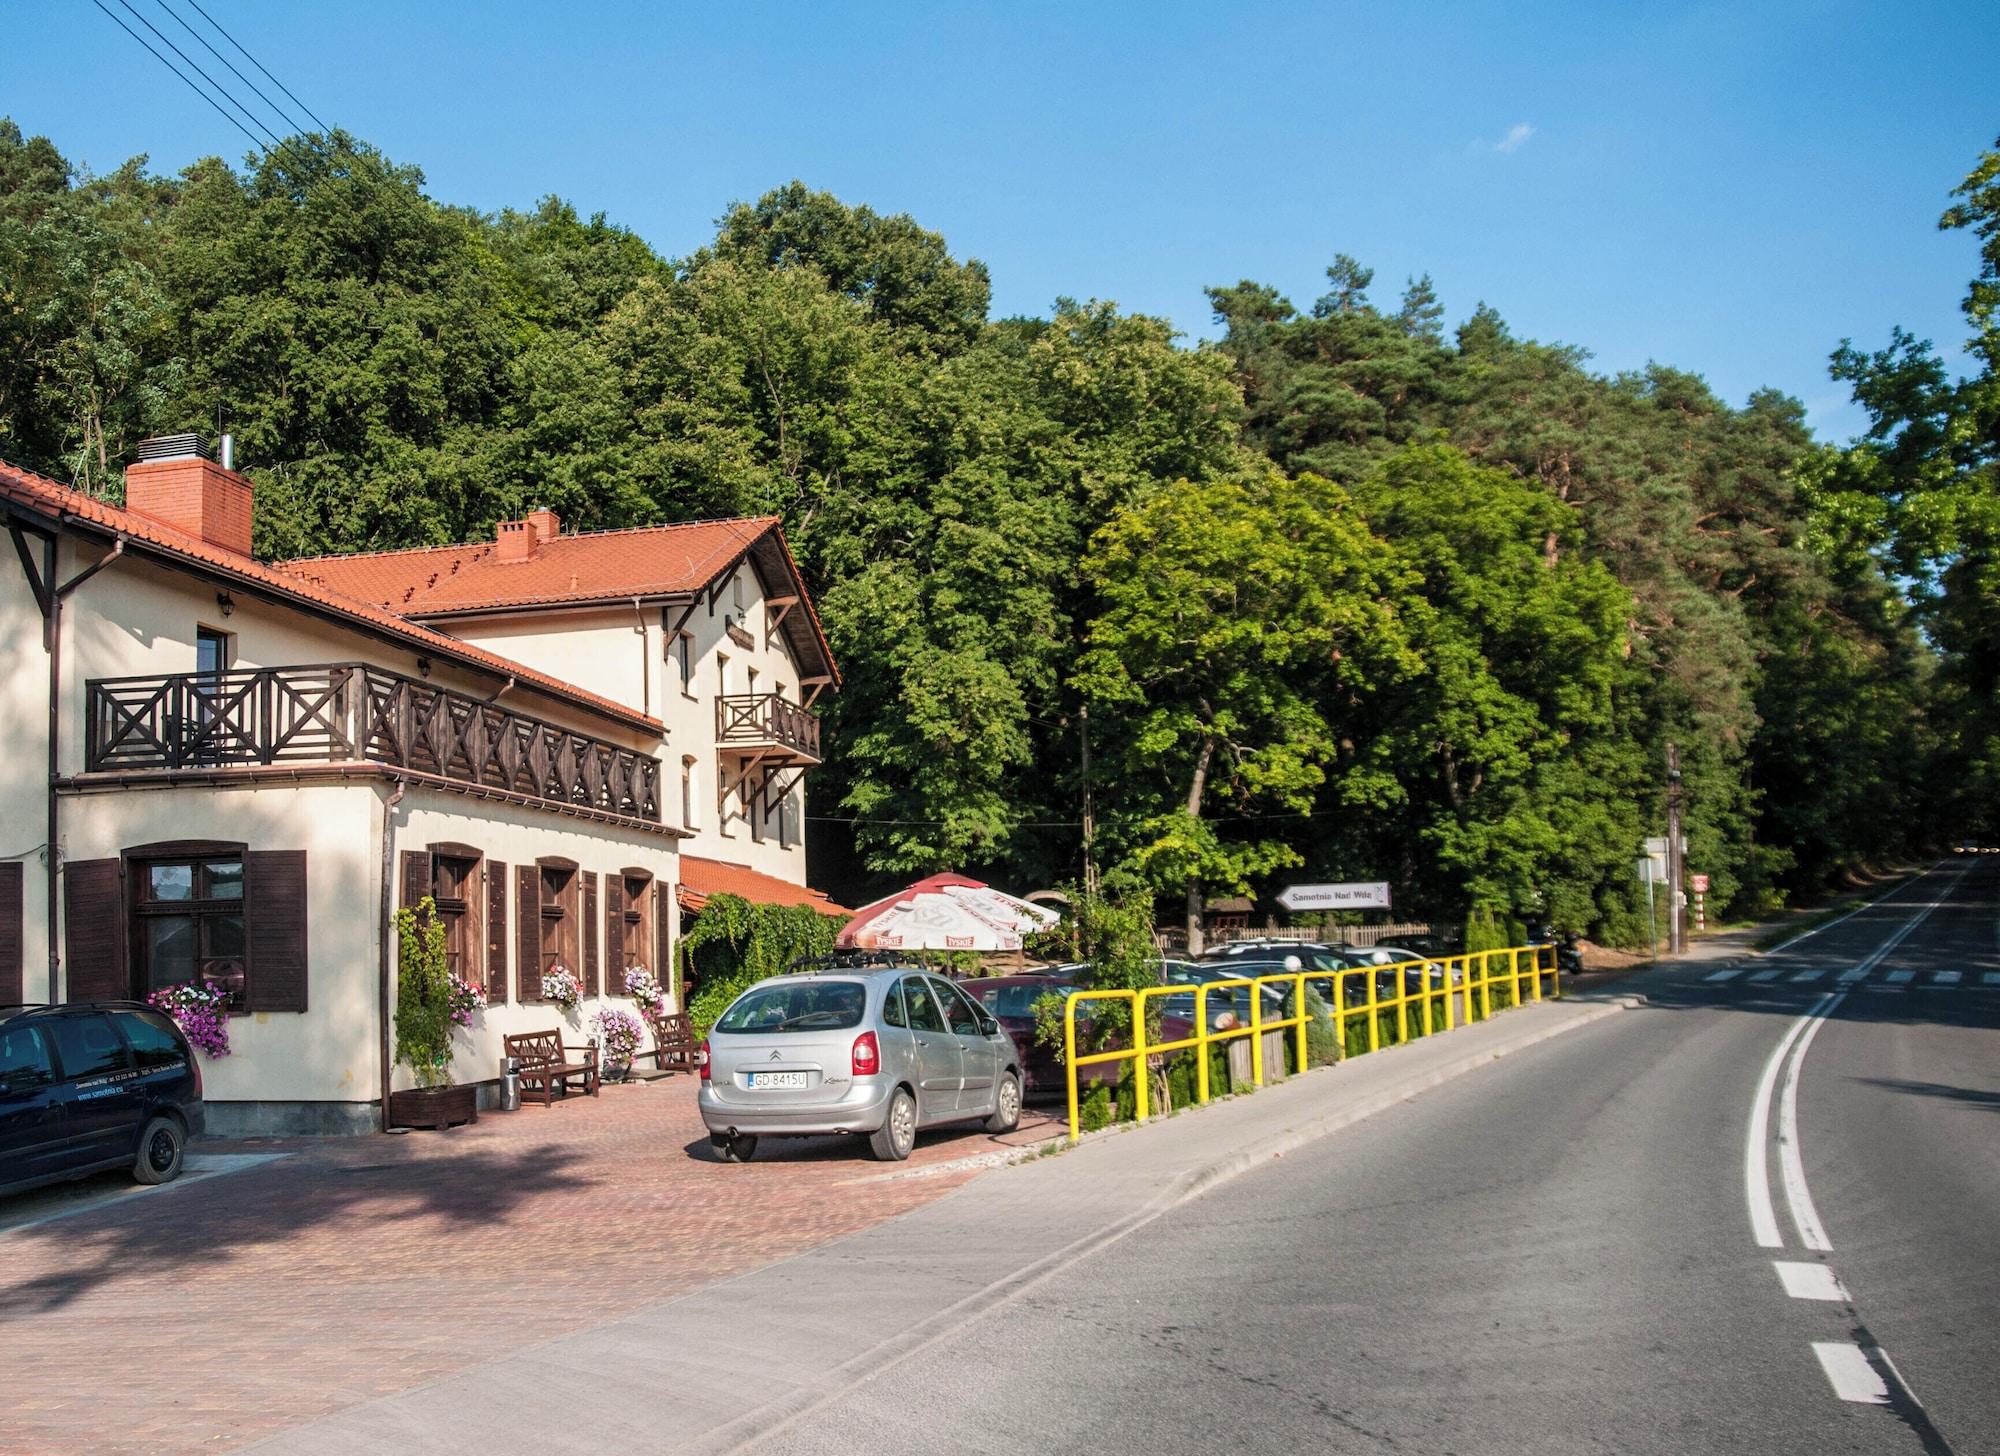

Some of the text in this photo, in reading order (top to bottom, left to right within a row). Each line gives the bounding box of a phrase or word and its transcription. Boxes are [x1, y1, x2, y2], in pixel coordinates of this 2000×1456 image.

[1334, 891, 1351, 899] Nad
[876, 936, 903, 947] TYSKIE
[948, 936, 974, 947] TYSKIE
[755, 1072, 806, 1086] GD 8415U
